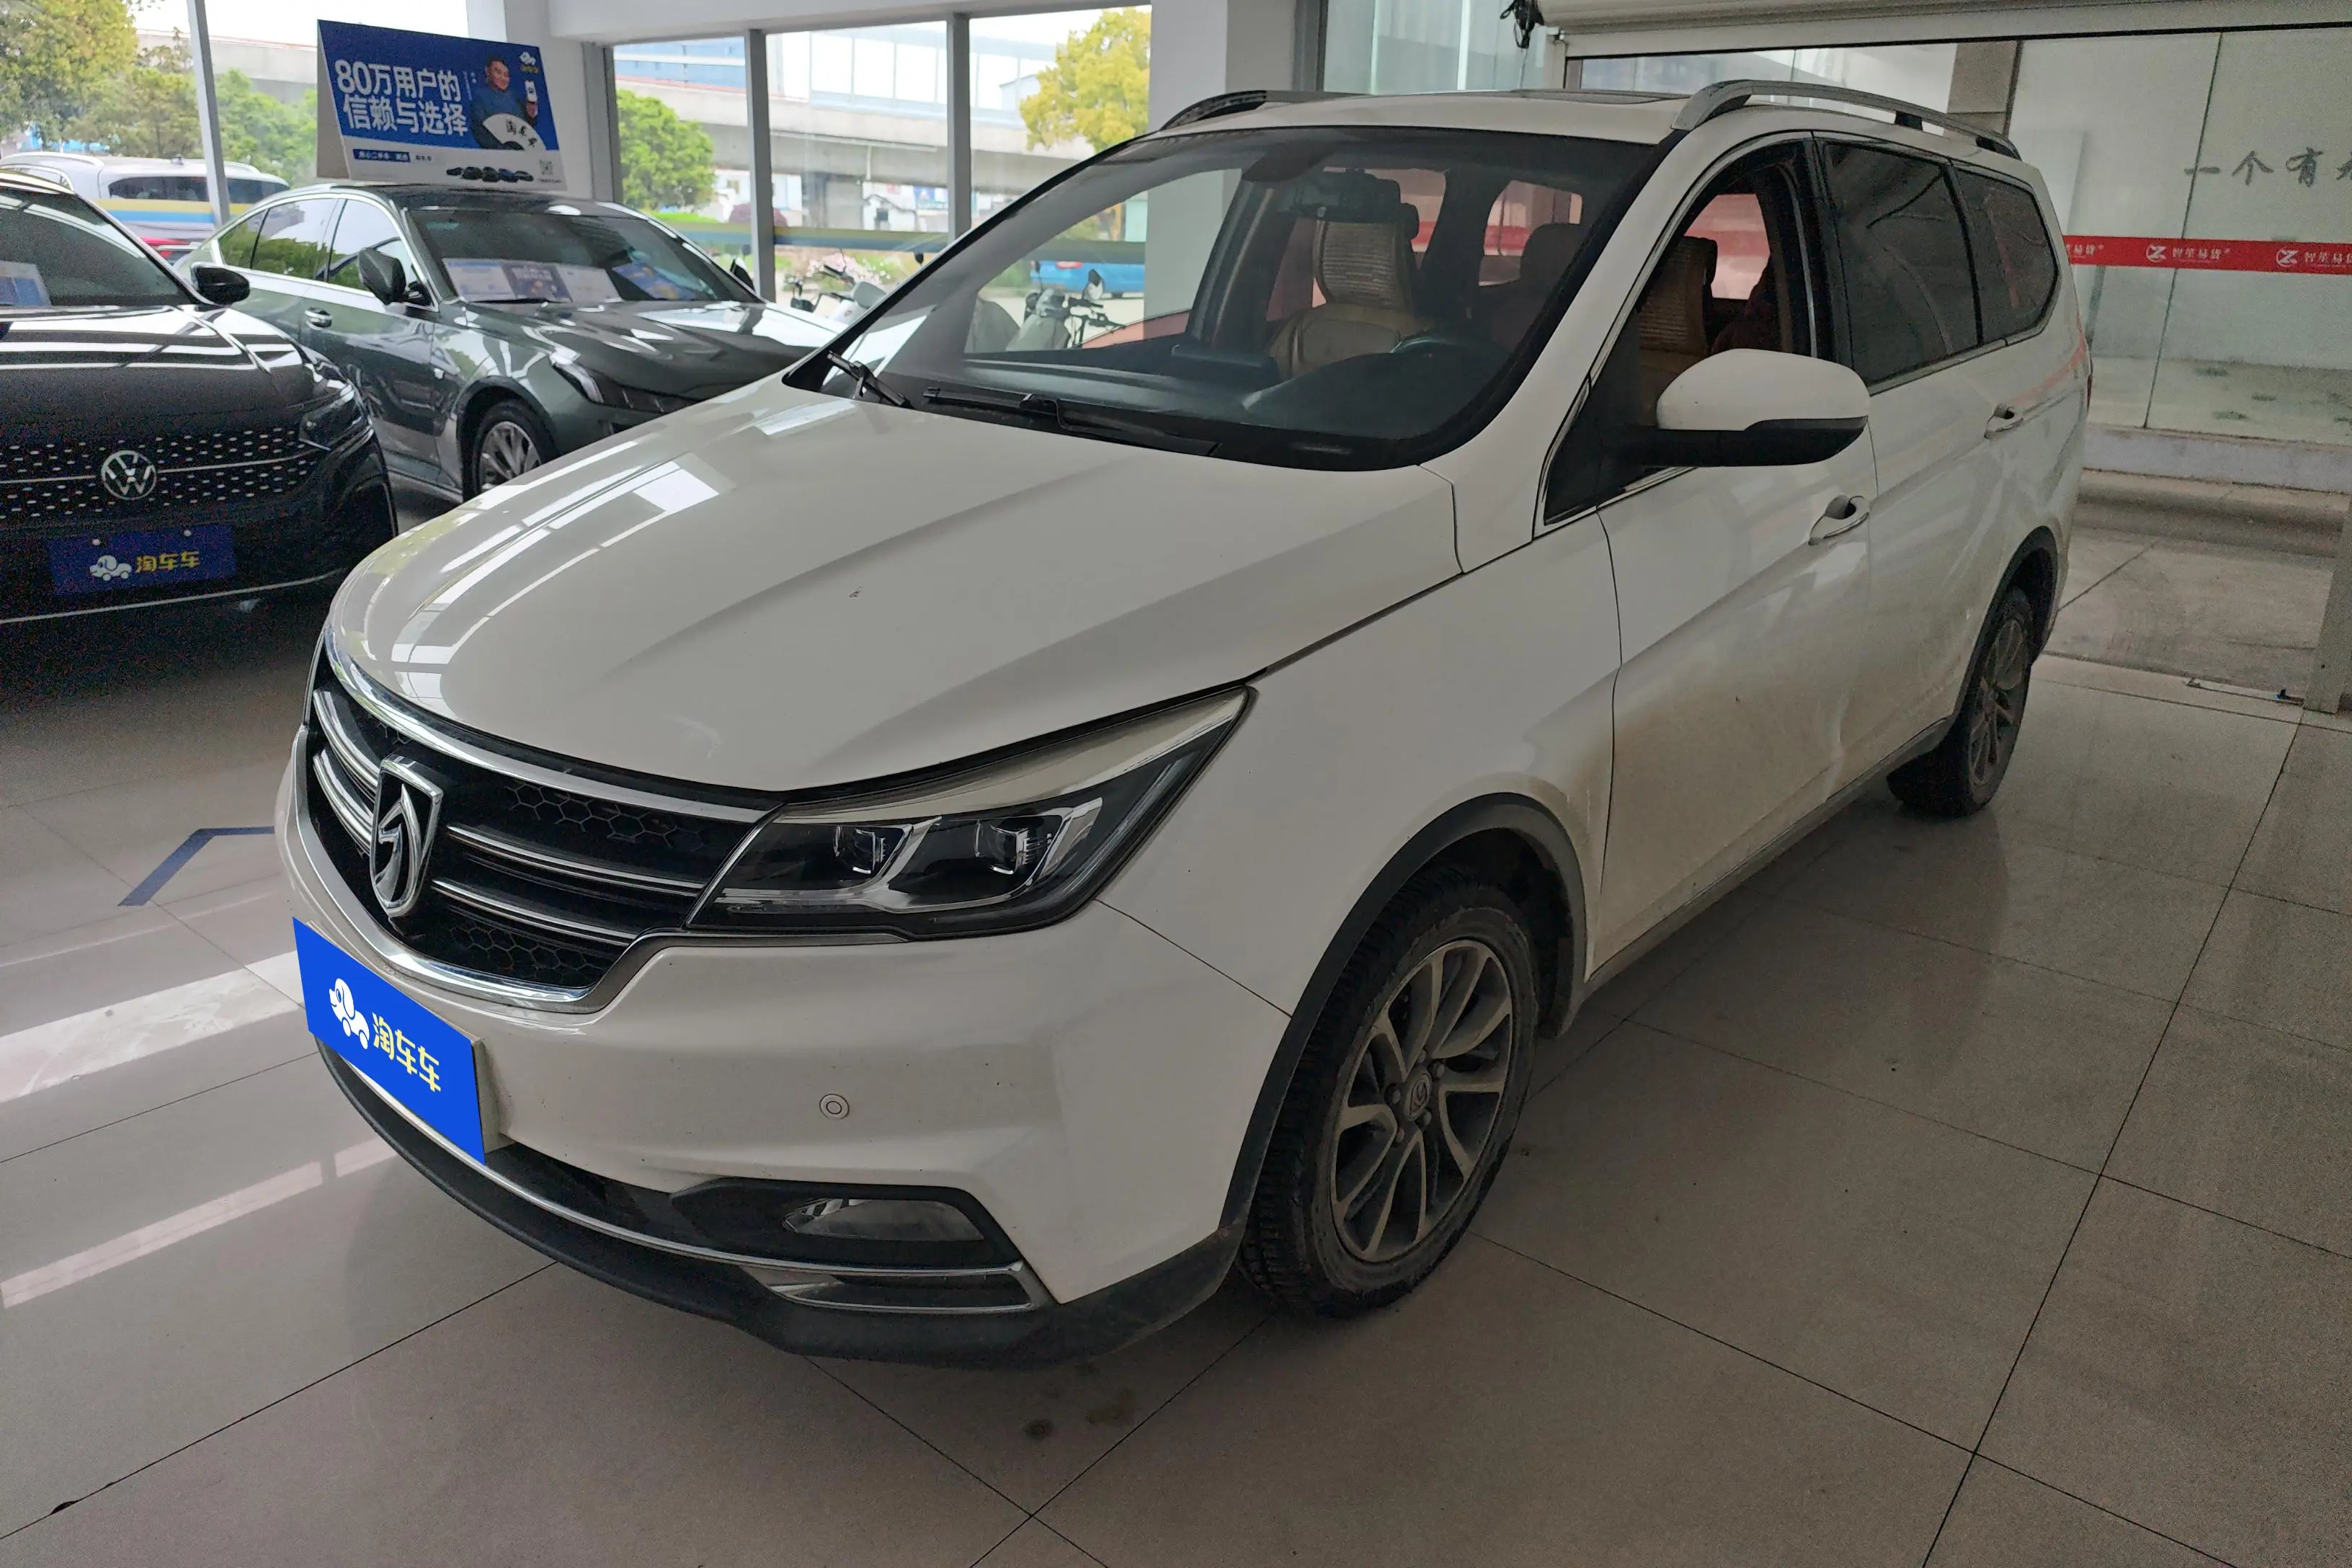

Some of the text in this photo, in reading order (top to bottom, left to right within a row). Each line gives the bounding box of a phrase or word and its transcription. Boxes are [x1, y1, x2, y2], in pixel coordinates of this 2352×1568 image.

[334, 59, 462, 102] 80万用户的
[342, 93, 468, 137] 信赖与选择
[135, 549, 200, 574] 淘车车
